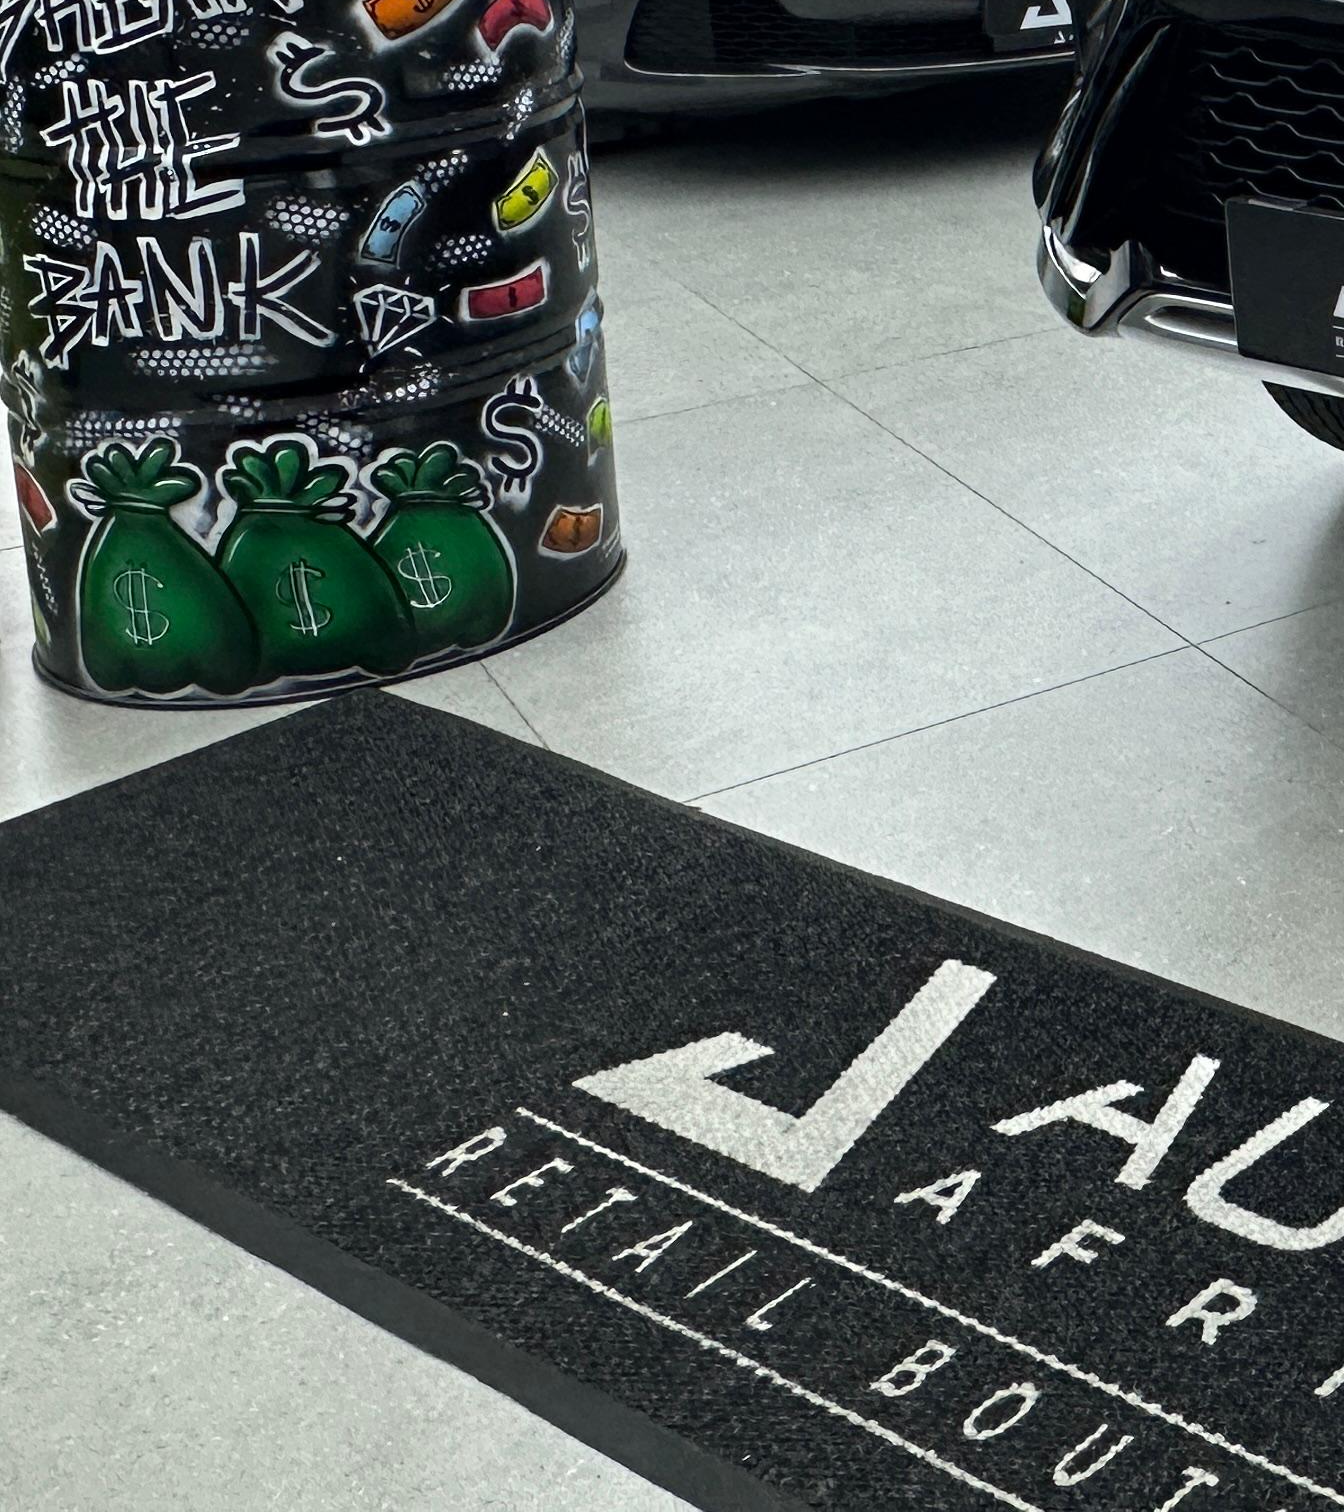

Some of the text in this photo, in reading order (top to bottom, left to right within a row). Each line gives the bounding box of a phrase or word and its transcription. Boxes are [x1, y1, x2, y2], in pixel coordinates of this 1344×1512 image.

[39, 71, 246, 220] THE
[22, 232, 337, 370] BANK
[425, 1125, 1222, 1512] RETAIL BOUT
